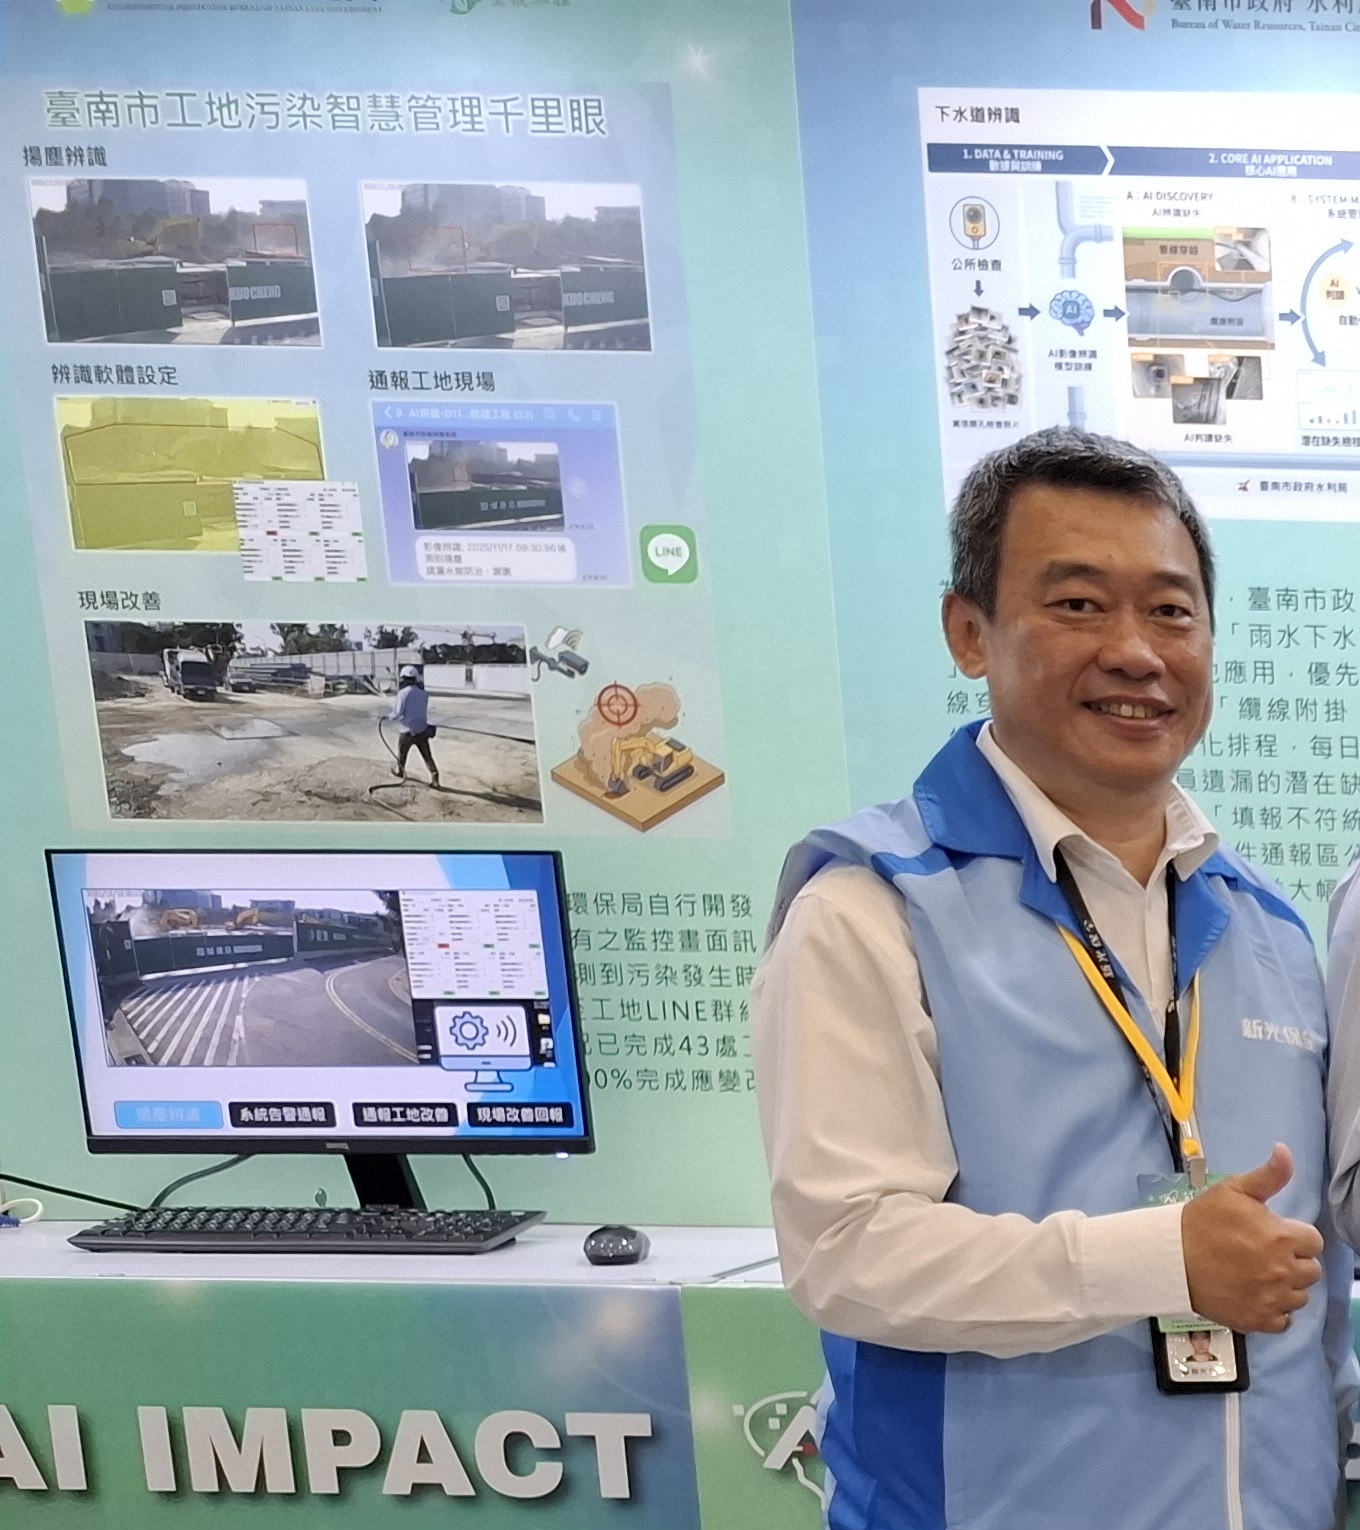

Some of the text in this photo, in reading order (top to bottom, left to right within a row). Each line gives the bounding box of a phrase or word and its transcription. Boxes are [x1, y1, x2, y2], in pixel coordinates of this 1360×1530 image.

[43, 89, 608, 136] 臺南市工地污染智慧管理千里眼
[935, 106, 1021, 124] 下水道辨識
[368, 370, 495, 392] 通報工地現場
[581, 998, 749, 1023] 工地LINE群
[586, 1068, 755, 1093] 0%完成應變
[138, 1405, 653, 1501] IMPACT
